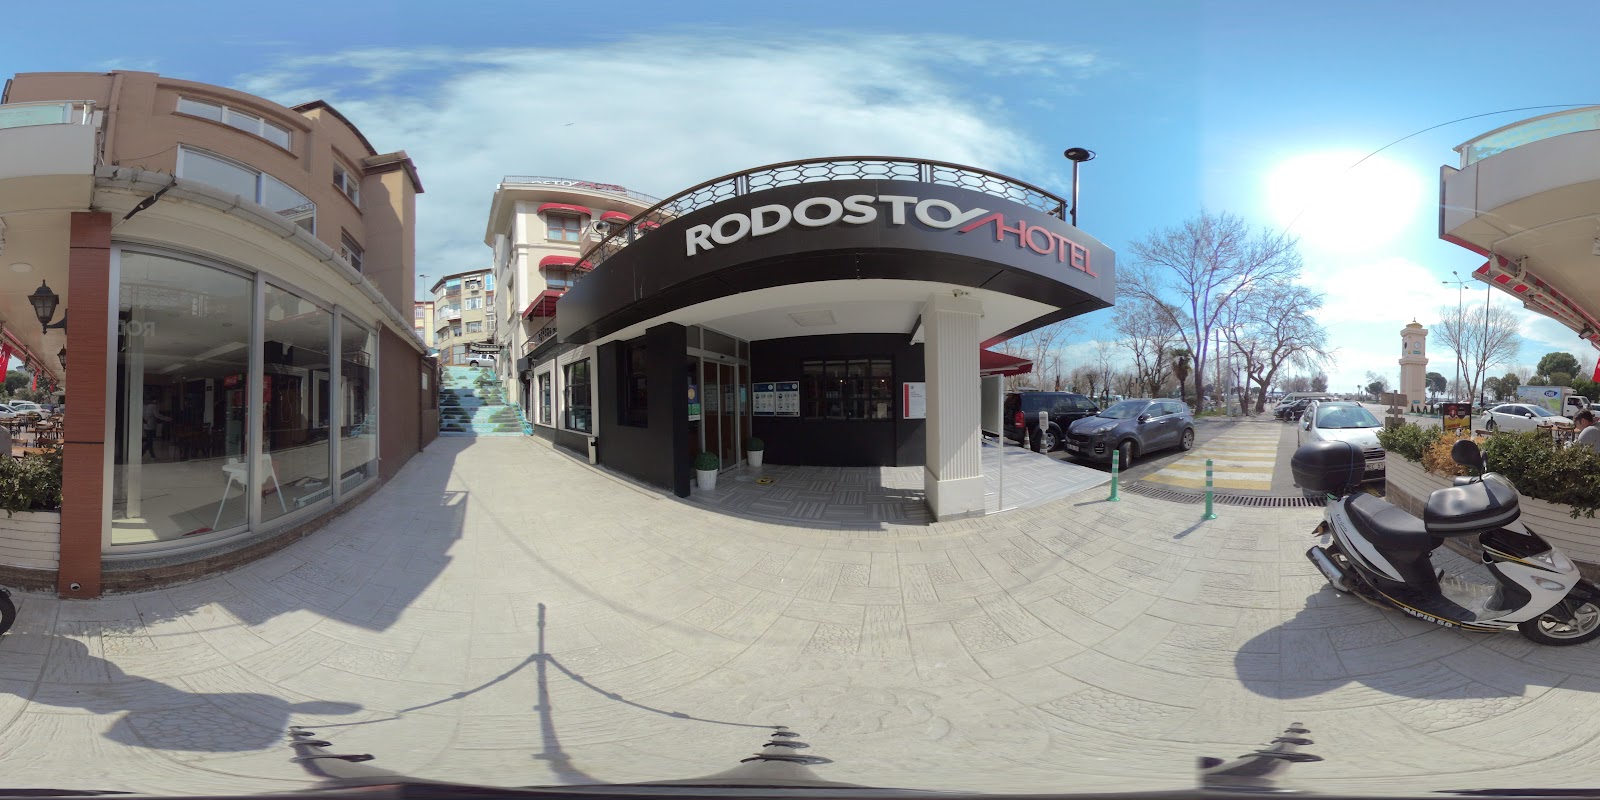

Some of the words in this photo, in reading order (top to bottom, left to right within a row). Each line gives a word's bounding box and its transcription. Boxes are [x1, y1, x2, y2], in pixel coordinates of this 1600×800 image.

[685, 194, 989, 257] RODOSTO
[958, 212, 1098, 278] HOTEL
[1403, 606, 1436, 623] RAPID
[1436, 619, 1453, 628] 50
